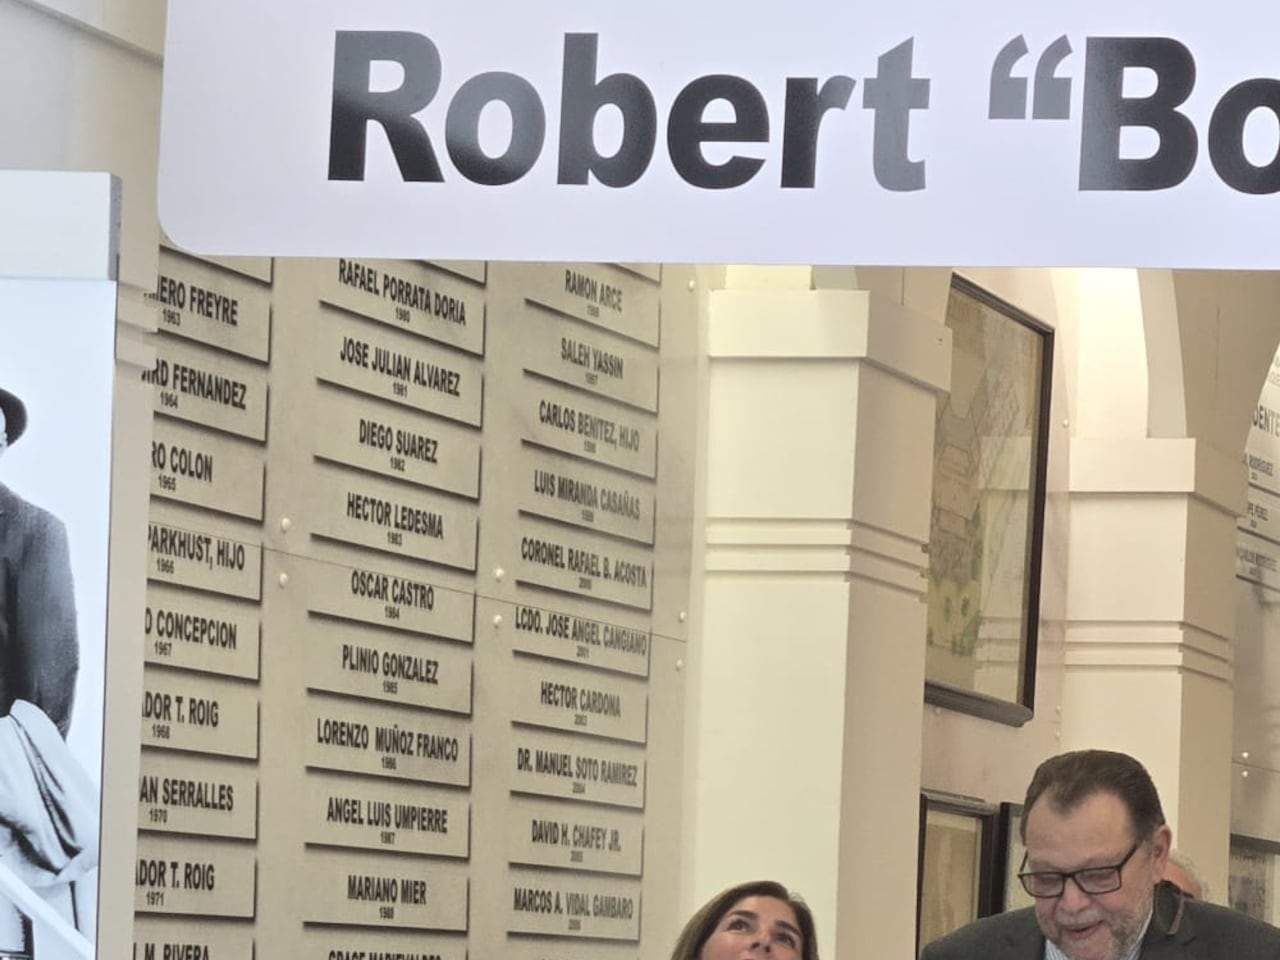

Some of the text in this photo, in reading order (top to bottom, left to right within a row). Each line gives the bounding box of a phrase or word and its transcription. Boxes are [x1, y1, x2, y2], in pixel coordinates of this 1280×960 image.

[328, 30, 931, 192] Robert
[158, 275, 239, 326] ERO FREYRE
[339, 258, 466, 326] RAFAEL PORRATA DORIA
[565, 269, 622, 312] RAMON ARCE
[163, 309, 181, 326] 1963
[340, 336, 460, 397] JOSE JULIAN ALVAREZ
[561, 338, 623, 379] SALEH YASSIN
[160, 392, 178, 408] 1964
[173, 364, 247, 410] FERNANDEZ
[359, 418, 438, 463] DIEGO SUAREZ
[539, 400, 576, 432] CARLOS
[619, 425, 640, 452] HIJO
[158, 474, 176, 491] 1965
[170, 446, 213, 483] COLON
[534, 470, 555, 496] LUIS
[557, 473, 598, 508] MIRANDA
[347, 492, 443, 539] HECTOR LEDESMA
[157, 558, 174, 574] 1966
[217, 539, 245, 570] HIJO
[521, 536, 565, 569] CORONEL
[568, 548, 600, 577] RAFAEL
[614, 560, 647, 588] ACOSTA
[351, 570, 434, 610] OSCAR CASTRO
[157, 610, 237, 649] CONCEPCION
[546, 613, 569, 639] JOSE
[572, 619, 600, 645] ANGEL
[155, 641, 172, 656] 1967
[342, 644, 438, 684] PLINIO GONZALEZ
[142, 691, 219, 727] DOR T. ROIG
[541, 680, 621, 717] HECTOR CARDONA
[317, 718, 458, 762] LORENZO MUÑOZ FRANCO
[517, 747, 637, 787] DR. MANUEL SOTO RAMIREZ
[163, 778, 233, 811] SERRALLES
[150, 808, 167, 823] 1970
[327, 796, 447, 833] ANGEL LUIS UMPIERRE
[532, 820, 559, 845] DAVID
[573, 824, 606, 850] CHAFEY
[608, 829, 621, 852] JR.
[136, 859, 215, 890] DOR T. ROIG
[348, 875, 426, 905] MARIANO MIER
[146, 892, 164, 905] 1971
[514, 888, 552, 914] MARCOS
[554, 892, 563, 915] A.
[566, 892, 590, 917] VIDAL
